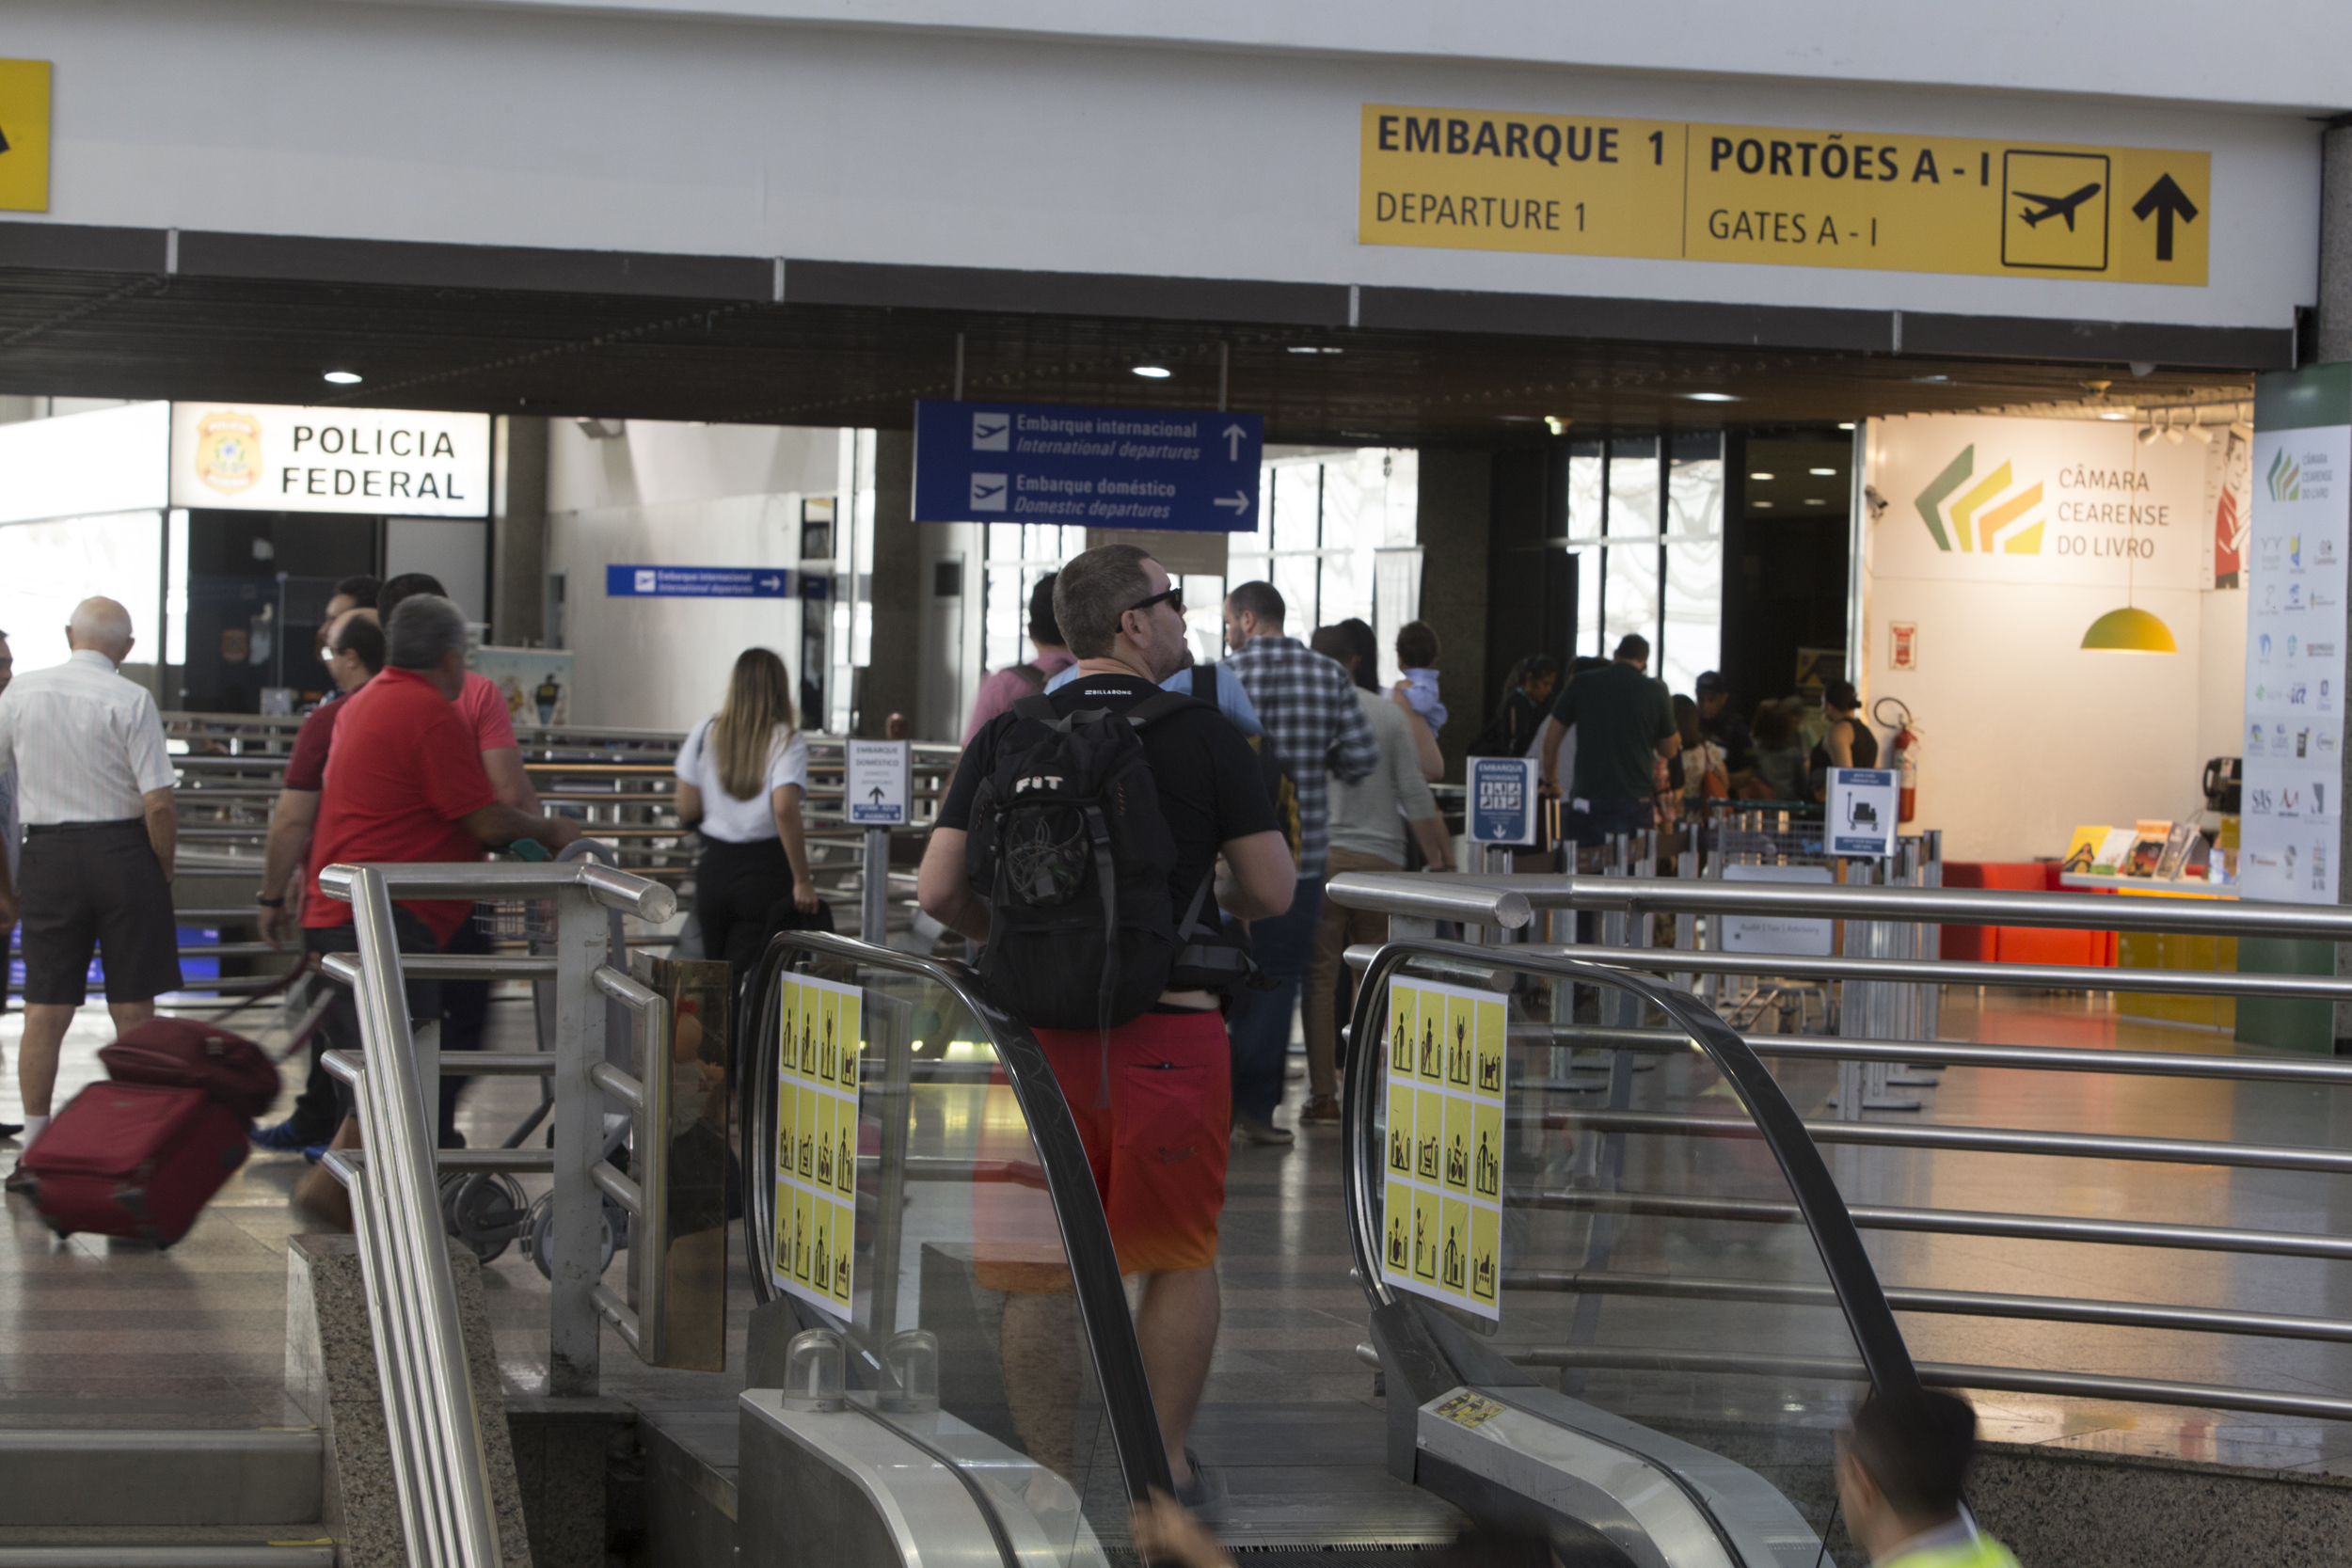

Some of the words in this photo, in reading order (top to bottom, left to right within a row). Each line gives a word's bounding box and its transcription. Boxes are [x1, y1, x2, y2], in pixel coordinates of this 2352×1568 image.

[1378, 115, 1619, 166] EMBARQUE
[1648, 130, 1663, 166] 1
[1710, 134, 1899, 182] PORTÕES
[1911, 148, 1940, 184] A
[1980, 150, 1990, 186] I
[1376, 191, 1561, 231] DEPARTURE
[1574, 201, 1584, 232] 1
[1708, 208, 1806, 244] GATES
[1817, 214, 1839, 245] A
[1016, 413, 1093, 436] Embarque
[1096, 418, 1198, 439] internacional
[1015, 436, 1117, 457] International
[1119, 440, 1201, 461] departures
[281, 467, 466, 500] FEDERAL
[1016, 473, 1092, 497] Embarque
[1096, 477, 1176, 498] doméstico
[2058, 463, 2150, 492] CÂMARA
[1013, 495, 1086, 515] Domestic
[1088, 499, 1171, 519] departures
[2058, 500, 2169, 527] CEARENSE
[2057, 534, 2087, 557] DO
[2093, 536, 2154, 560] LIVRO
[856, 746, 898, 755] EMBARQUE
[1478, 763, 1524, 773] EMBARQUE
[1016, 775, 1064, 794] FIT
